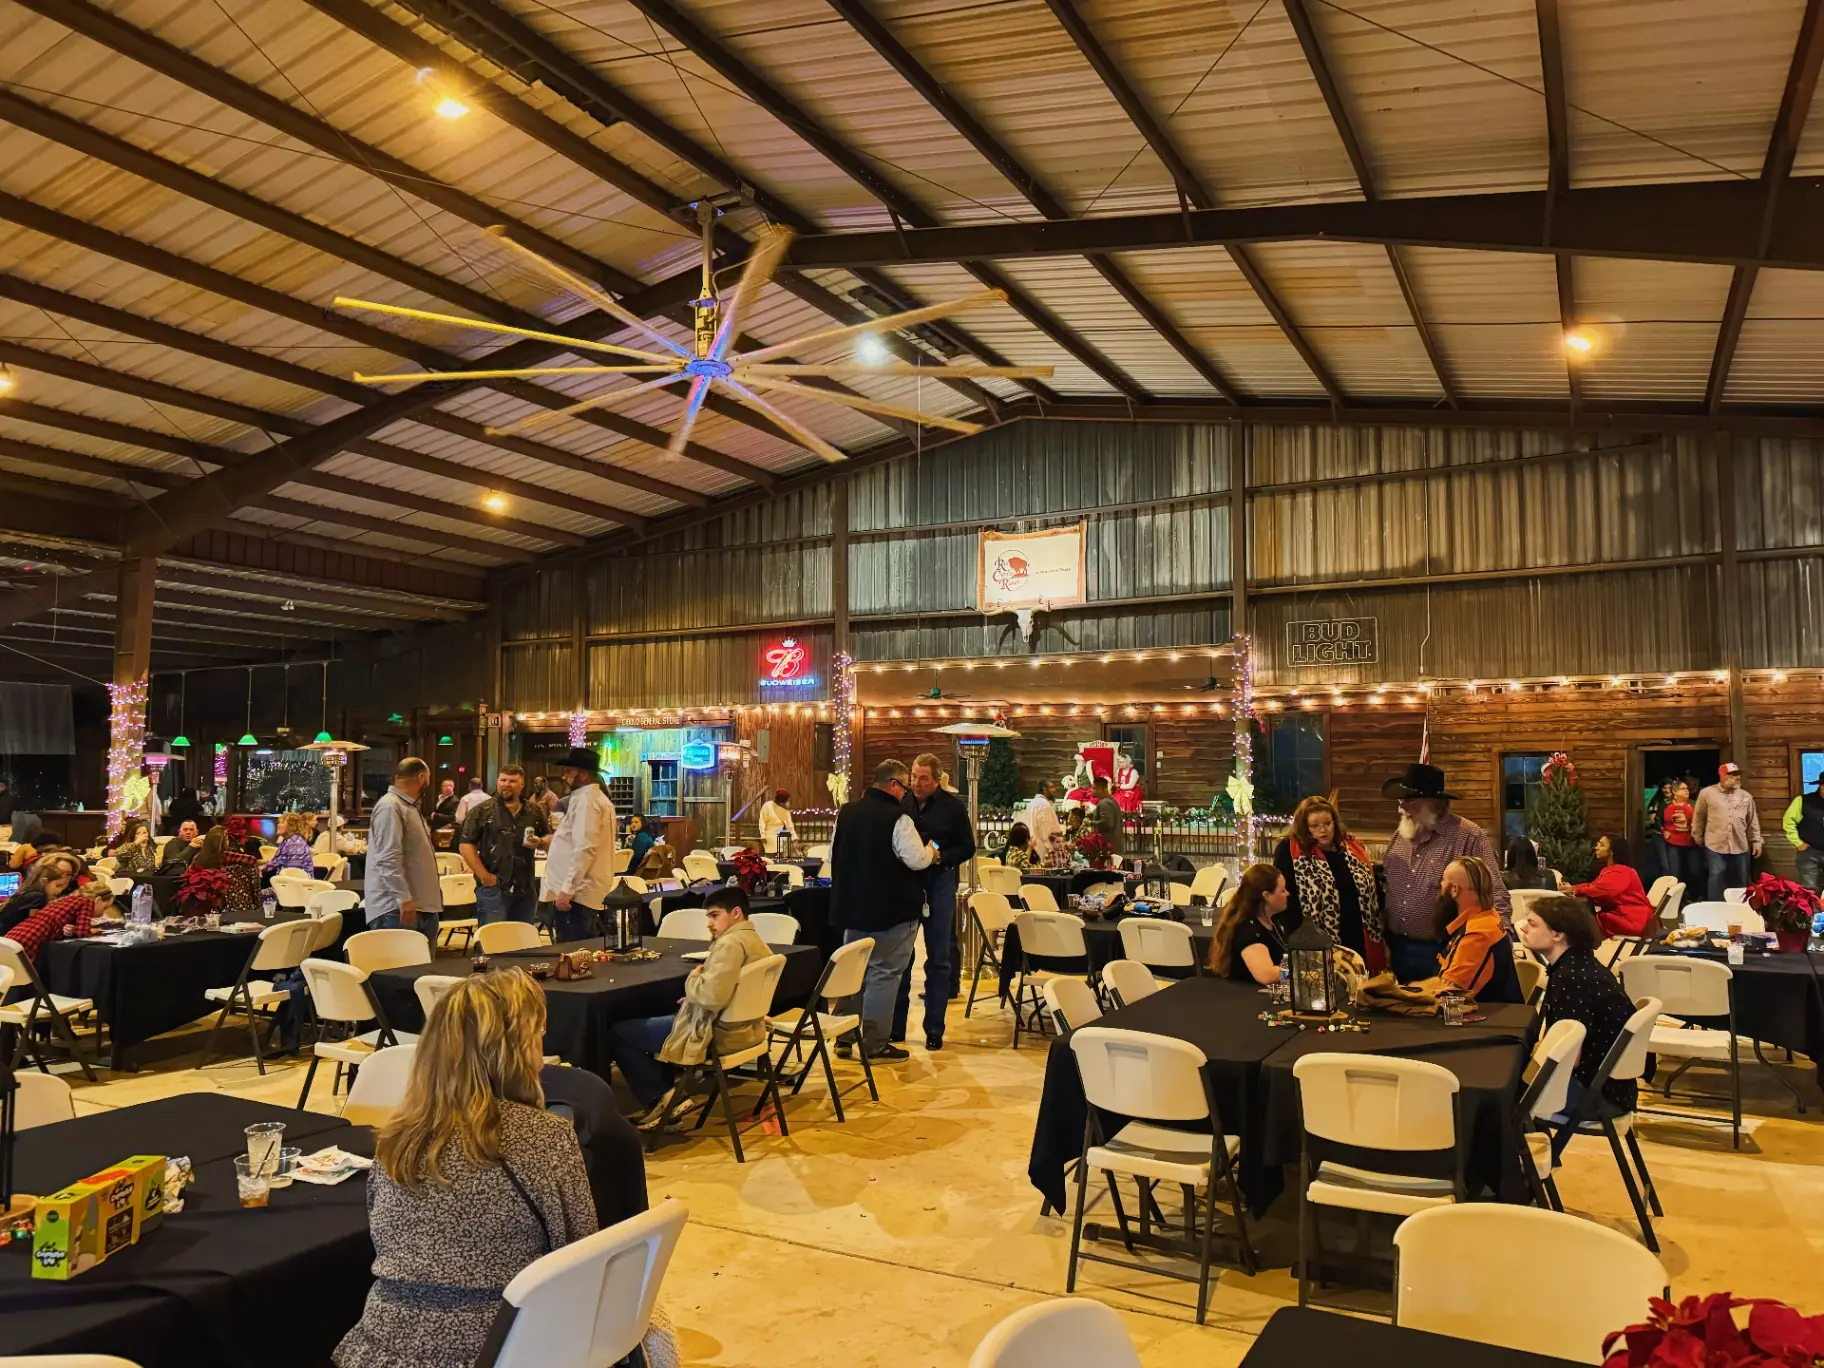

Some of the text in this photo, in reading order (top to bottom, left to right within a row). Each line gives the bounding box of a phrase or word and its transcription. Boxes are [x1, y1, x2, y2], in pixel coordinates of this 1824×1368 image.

[1303, 621, 1360, 642] BUD
[1292, 640, 1371, 662] LIGHT
[759, 678, 815, 687] BUDWEISER
[640, 716, 661, 726] GENERAL
[662, 715, 680, 725] STORE
[983, 830, 1007, 851] Cib
